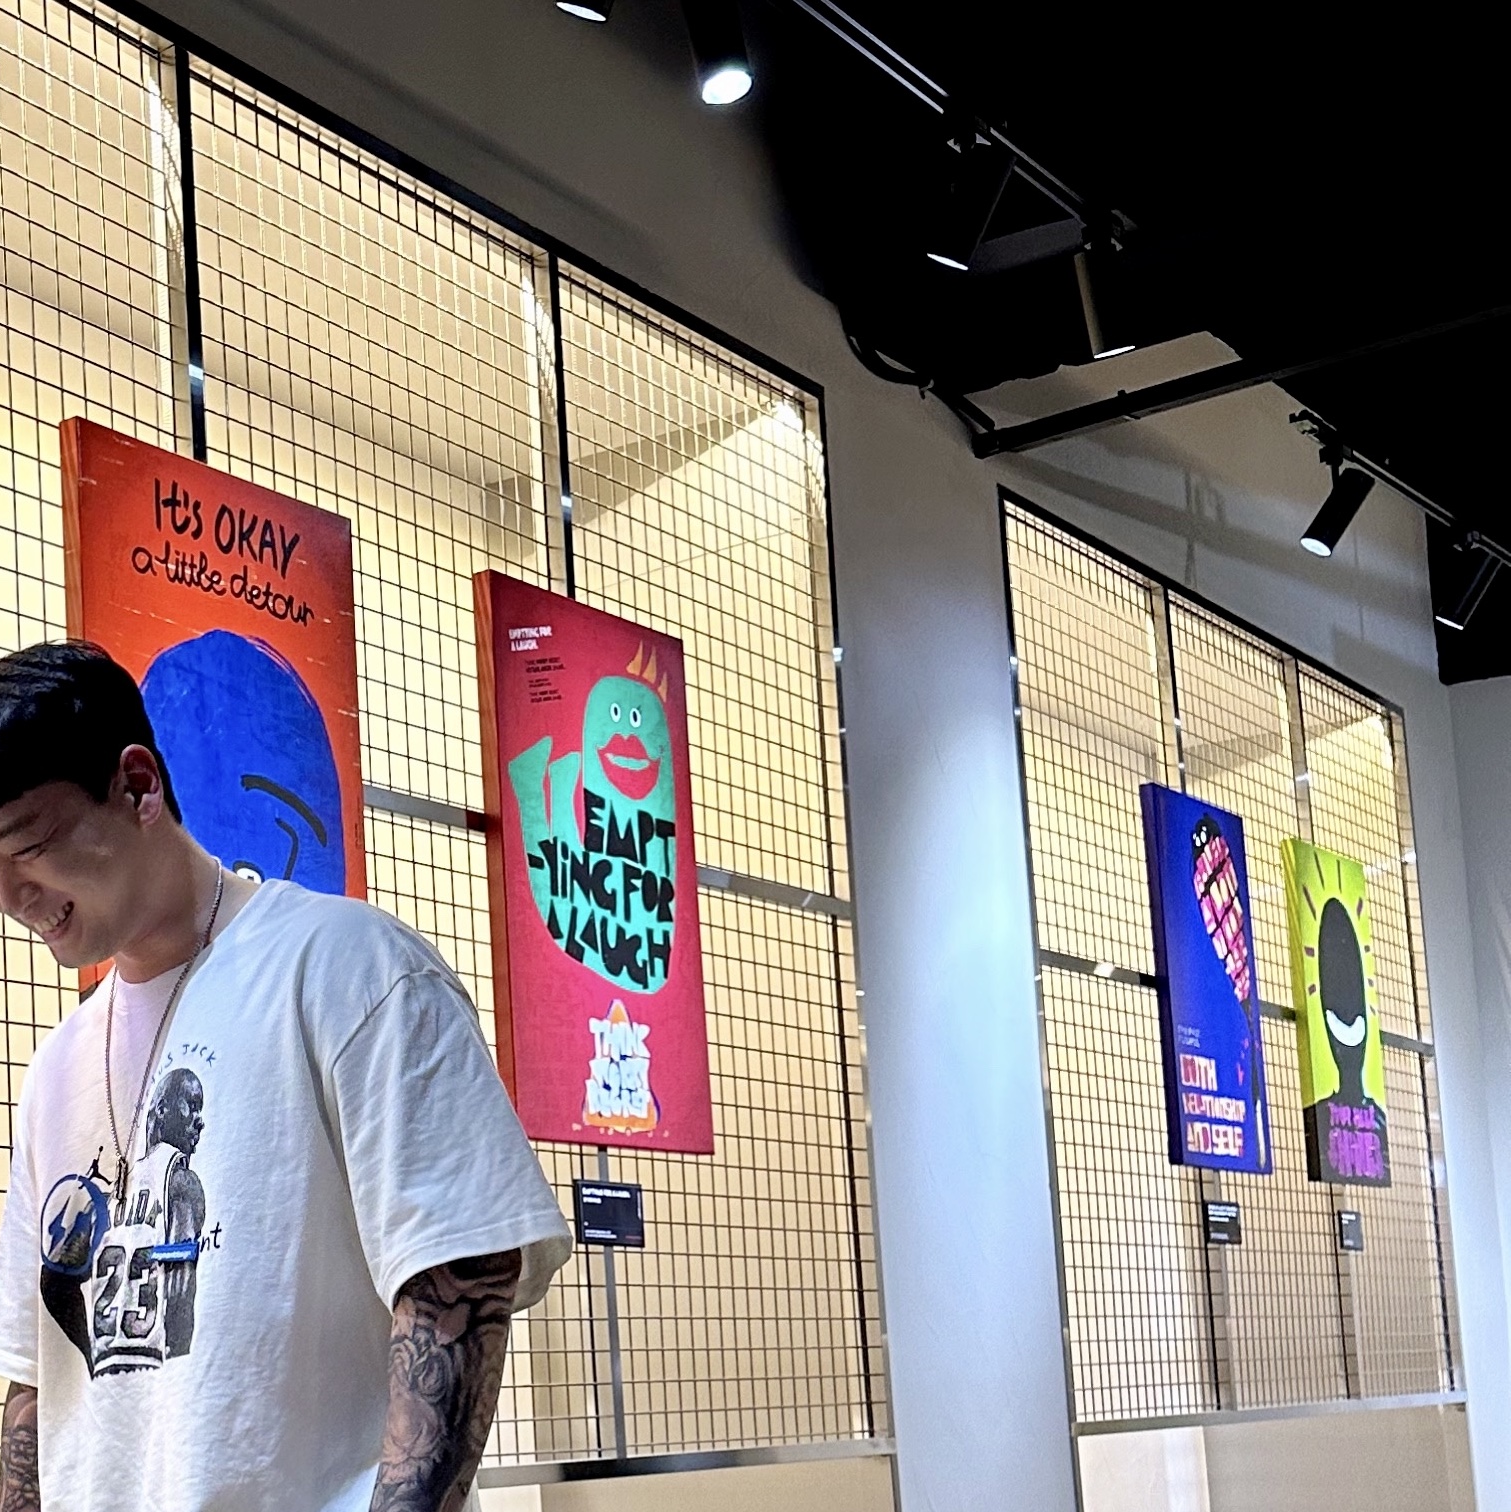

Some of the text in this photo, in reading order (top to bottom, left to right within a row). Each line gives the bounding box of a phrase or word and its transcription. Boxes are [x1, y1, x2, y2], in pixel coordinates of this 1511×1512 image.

[214, 503, 300, 579] OKAY
[155, 540, 226, 596] little
[230, 565, 315, 627] detour
[622, 860, 675, 923] FOR
[565, 906, 671, 990] LAUGH
[92, 1245, 160, 1339] 23
